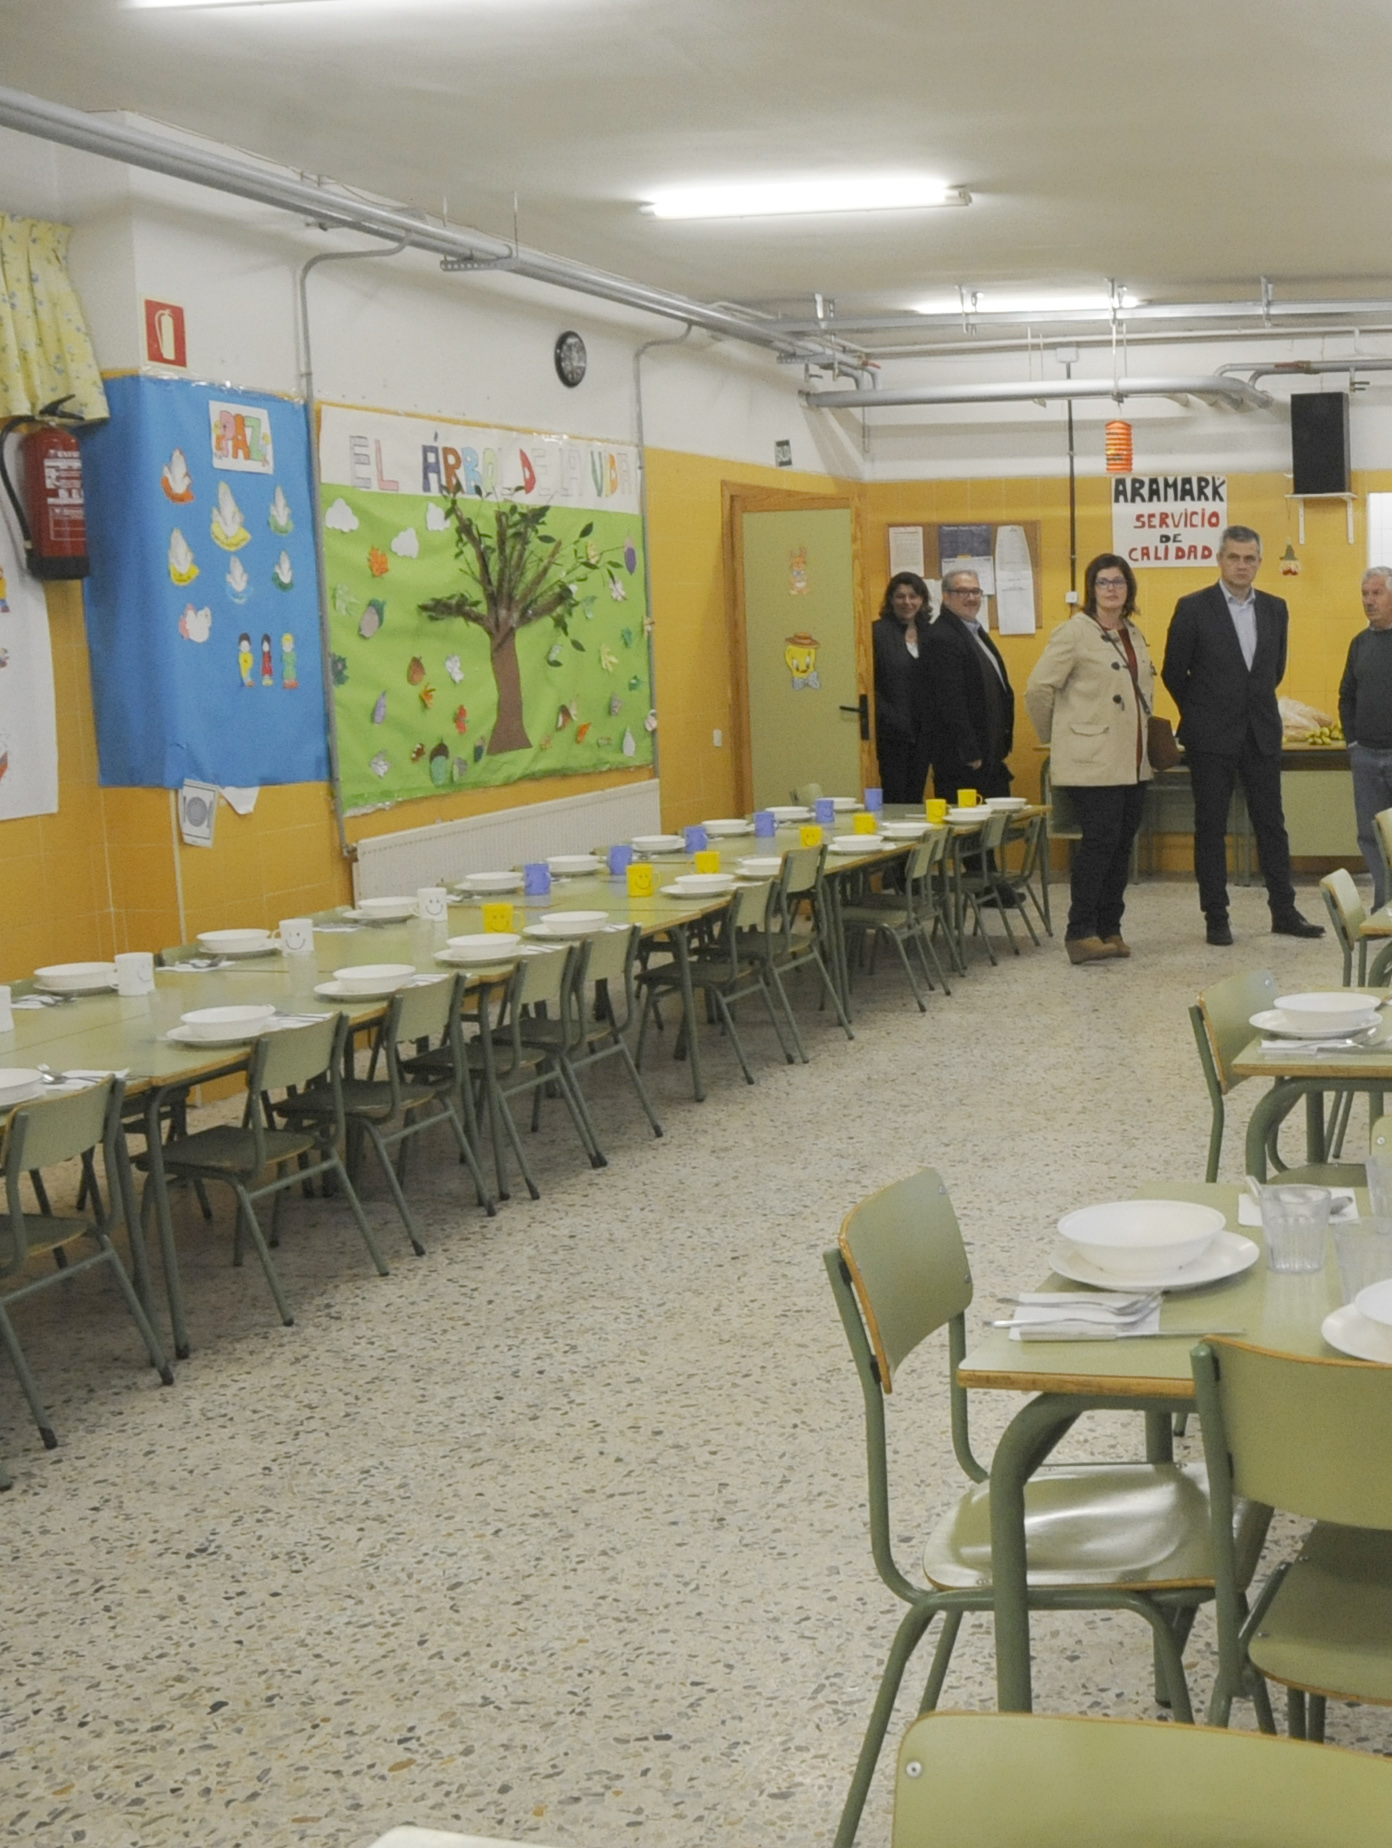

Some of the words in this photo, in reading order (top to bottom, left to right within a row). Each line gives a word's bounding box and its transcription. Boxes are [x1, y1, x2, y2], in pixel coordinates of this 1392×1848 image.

[219, 410, 263, 462] PAZ
[350, 435, 399, 491] EL
[519, 447, 554, 497] DE
[590, 450, 632, 497] VIDA
[1114, 475, 1226, 503] ARAMARK
[1133, 508, 1220, 529] SERVICIO
[1159, 534, 1183, 543] DE
[1128, 545, 1213, 562] CALIDAD
